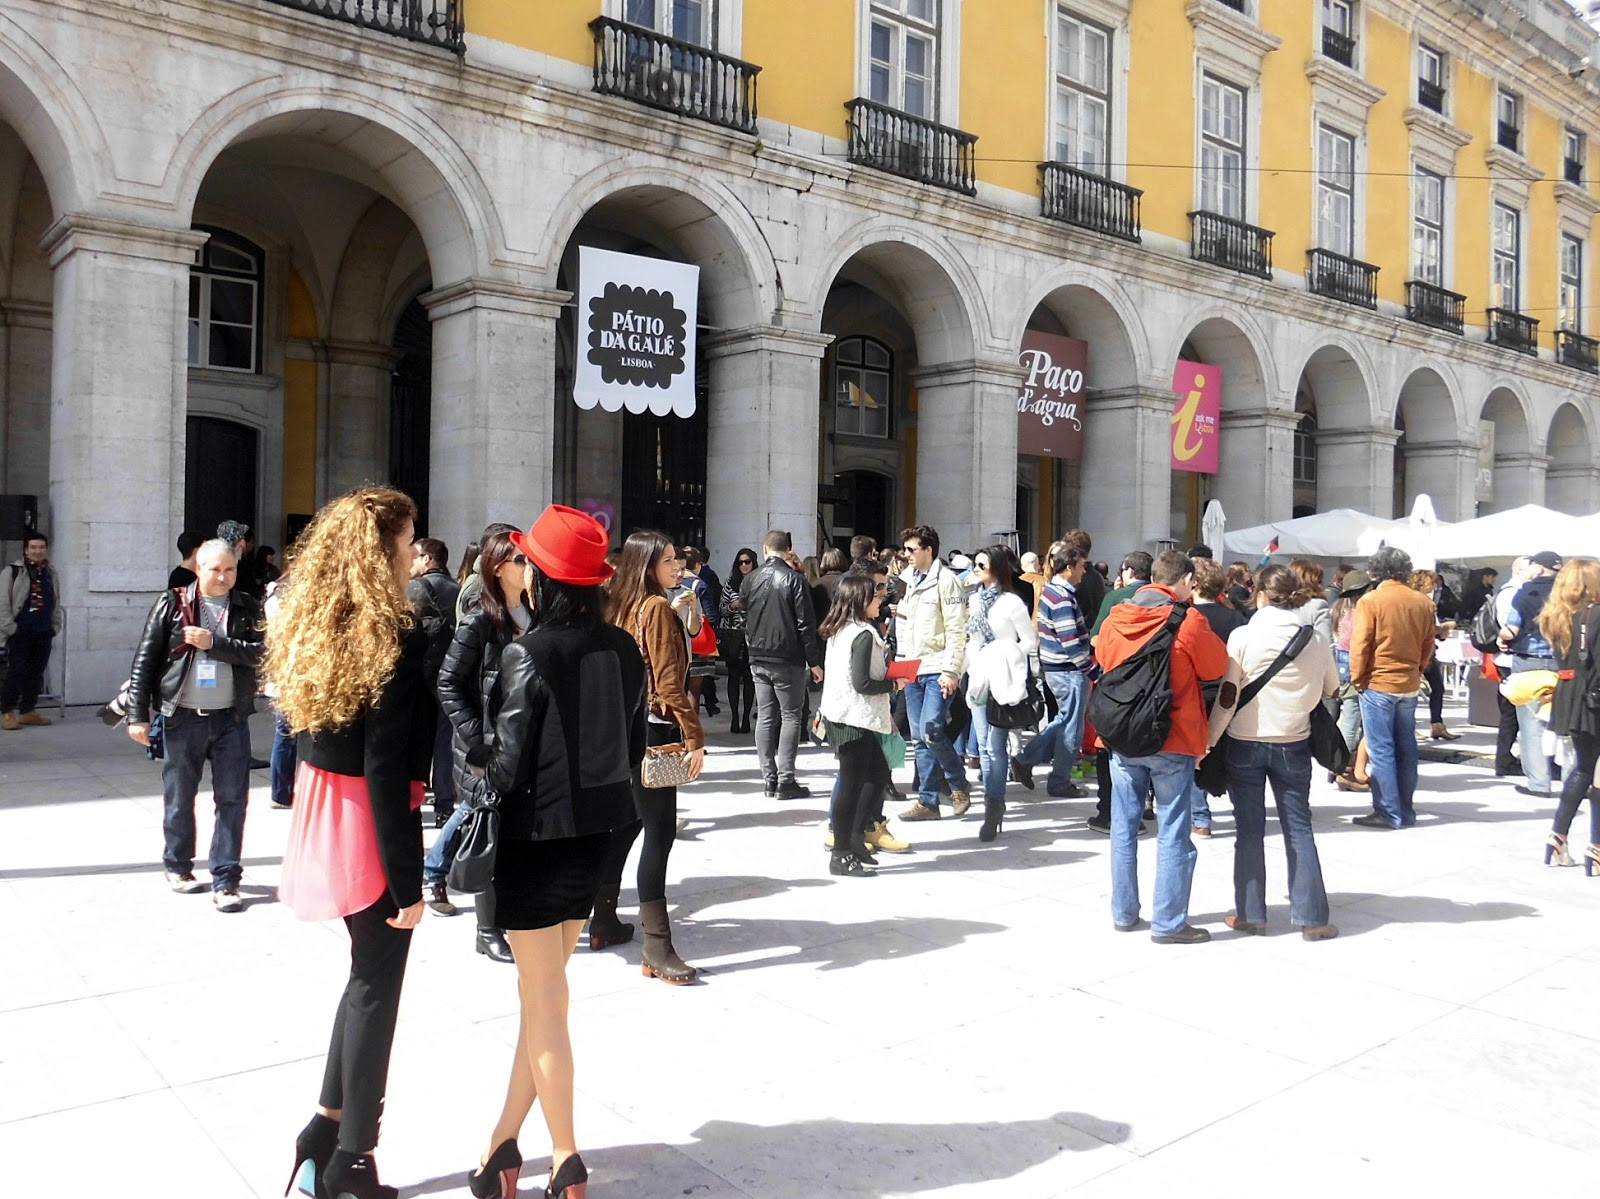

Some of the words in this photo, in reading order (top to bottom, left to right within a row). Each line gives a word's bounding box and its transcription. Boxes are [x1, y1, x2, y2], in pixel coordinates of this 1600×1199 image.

[612, 310, 664, 336] PÁTIO
[600, 330, 626, 350] DA
[628, 335, 675, 356] GALÉ
[621, 357, 653, 369] LISBOA
[1018, 349, 1083, 397] Paço
[1017, 388, 1082, 432] d'água
